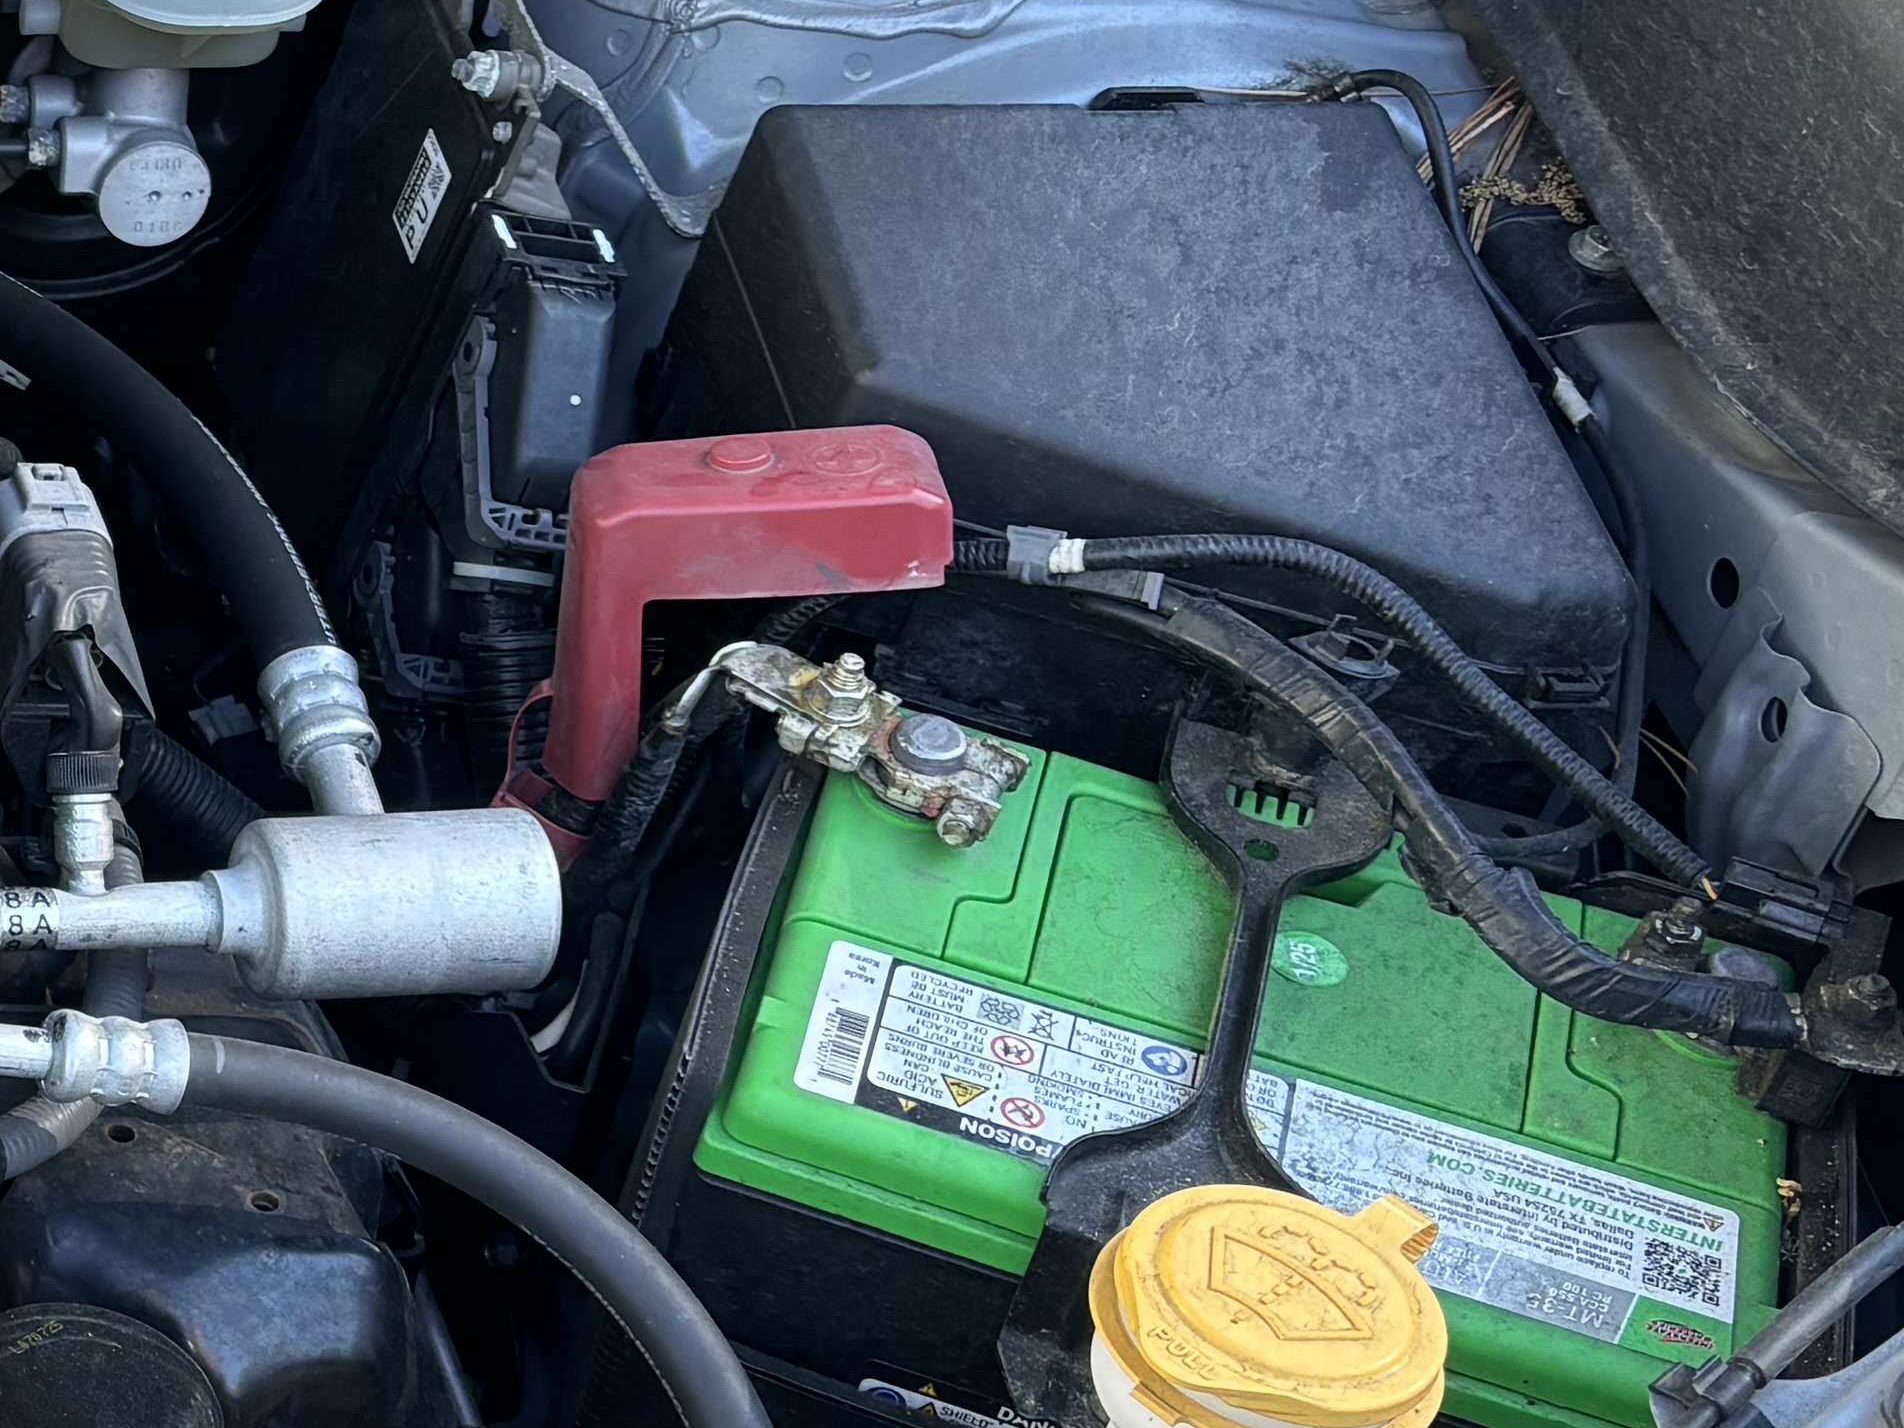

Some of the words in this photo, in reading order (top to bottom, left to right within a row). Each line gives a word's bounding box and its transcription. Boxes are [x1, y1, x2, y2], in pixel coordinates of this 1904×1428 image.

[7, 913, 24, 936] 8
[31, 912, 53, 935] A
[846, 951, 881, 968] Korea
[855, 962, 867, 973] in
[841, 968, 876, 985] Made
[909, 969, 974, 996] RECYCLED
[909, 980, 927, 992] BE
[906, 989, 963, 1013] BATTERY
[930, 986, 965, 1003] MUST
[905, 1003, 969, 1030] CHILDREN
[914, 1016, 958, 1036] REACH
[904, 1023, 921, 1034] OF
[922, 1028, 949, 1043] OUT
[960, 1030, 985, 1045] THE
[974, 1024, 989, 1036] OF
[886, 1032, 928, 1051] BURNS
[951, 1037, 984, 1054] KEEP
[883, 1041, 951, 1069] BLINDNESS
[902, 1057, 930, 1072] CAN
[930, 1046, 975, 1066] SEVERE
[1099, 1048, 1134, 1065] READ
[952, 1062, 993, 1082] CAUSE
[980, 1061, 995, 1072] OR
[1090, 1060, 1122, 1077] FAST
[874, 1070, 943, 1099] SULFURIC
[902, 1068, 937, 1086] ACID
[1025, 1072, 1085, 1099] SMOKING
[1049, 1067, 1136, 1102] IMMEDIATELY
[1123, 1070, 1160, 1089] HELP
[1032, 1084, 1083, 1107] FLAMES
[1032, 1094, 1081, 1116] SPARKS
[1412, 1174, 1475, 1202] Batteries
[1489, 1187, 1522, 1205] USA
[1424, 1149, 1724, 1253] INTERSTATEBATTERIES.COM
[1474, 1193, 1540, 1221] Interstate
[1521, 1197, 1567, 1219] 75254
[1474, 1206, 1531, 1230] authorized
[1541, 1212, 1559, 1227] by
[1567, 1211, 1586, 1225] TX
[1531, 1223, 1581, 1246] Batteries
[1558, 1219, 1635, 1251] Distributed
[1587, 1216, 1635, 1240] Dallas,
[1494, 1227, 1543, 1250] warranty
[1542, 1244, 1576, 1262] under
[1574, 1245, 1614, 1265] limited
[1580, 1238, 1634, 1262] Interstate
[1575, 1253, 1616, 1275] replace
[1614, 1257, 1632, 1271] For
[1615, 1267, 1631, 1280] To
[1561, 1279, 1589, 1296] 100
[1590, 1288, 1613, 1304] RC
[1577, 1294, 1610, 1313] CCA
[1146, 1323, 1219, 1383] PULL
